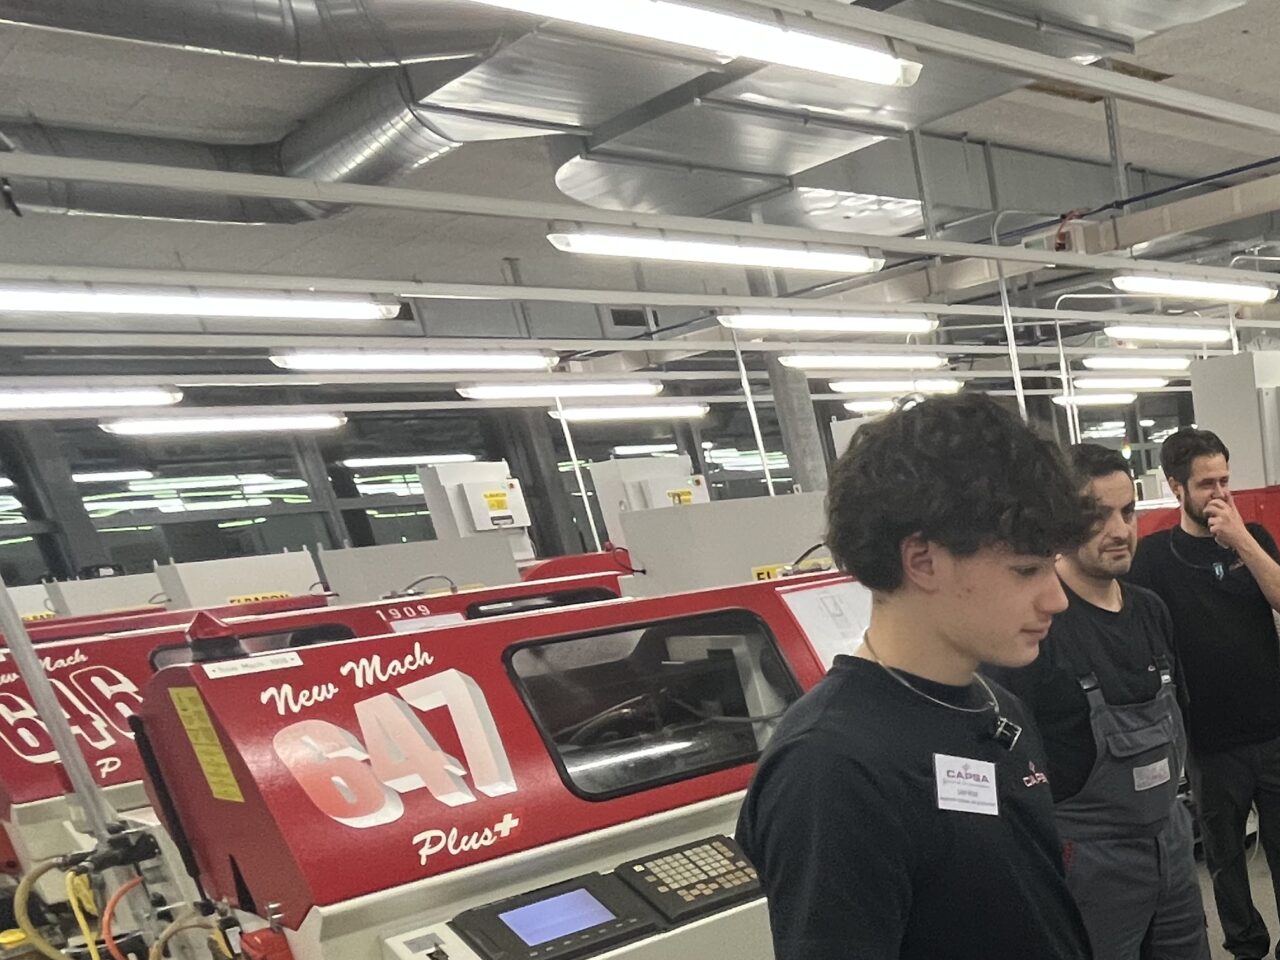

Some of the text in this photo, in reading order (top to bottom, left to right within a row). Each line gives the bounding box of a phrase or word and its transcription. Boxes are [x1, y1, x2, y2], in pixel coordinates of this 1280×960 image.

[375, 604, 431, 622] 1909
[260, 641, 434, 716] New Mach
[272, 667, 519, 829] 647
[946, 769, 990, 783] CAPSA
